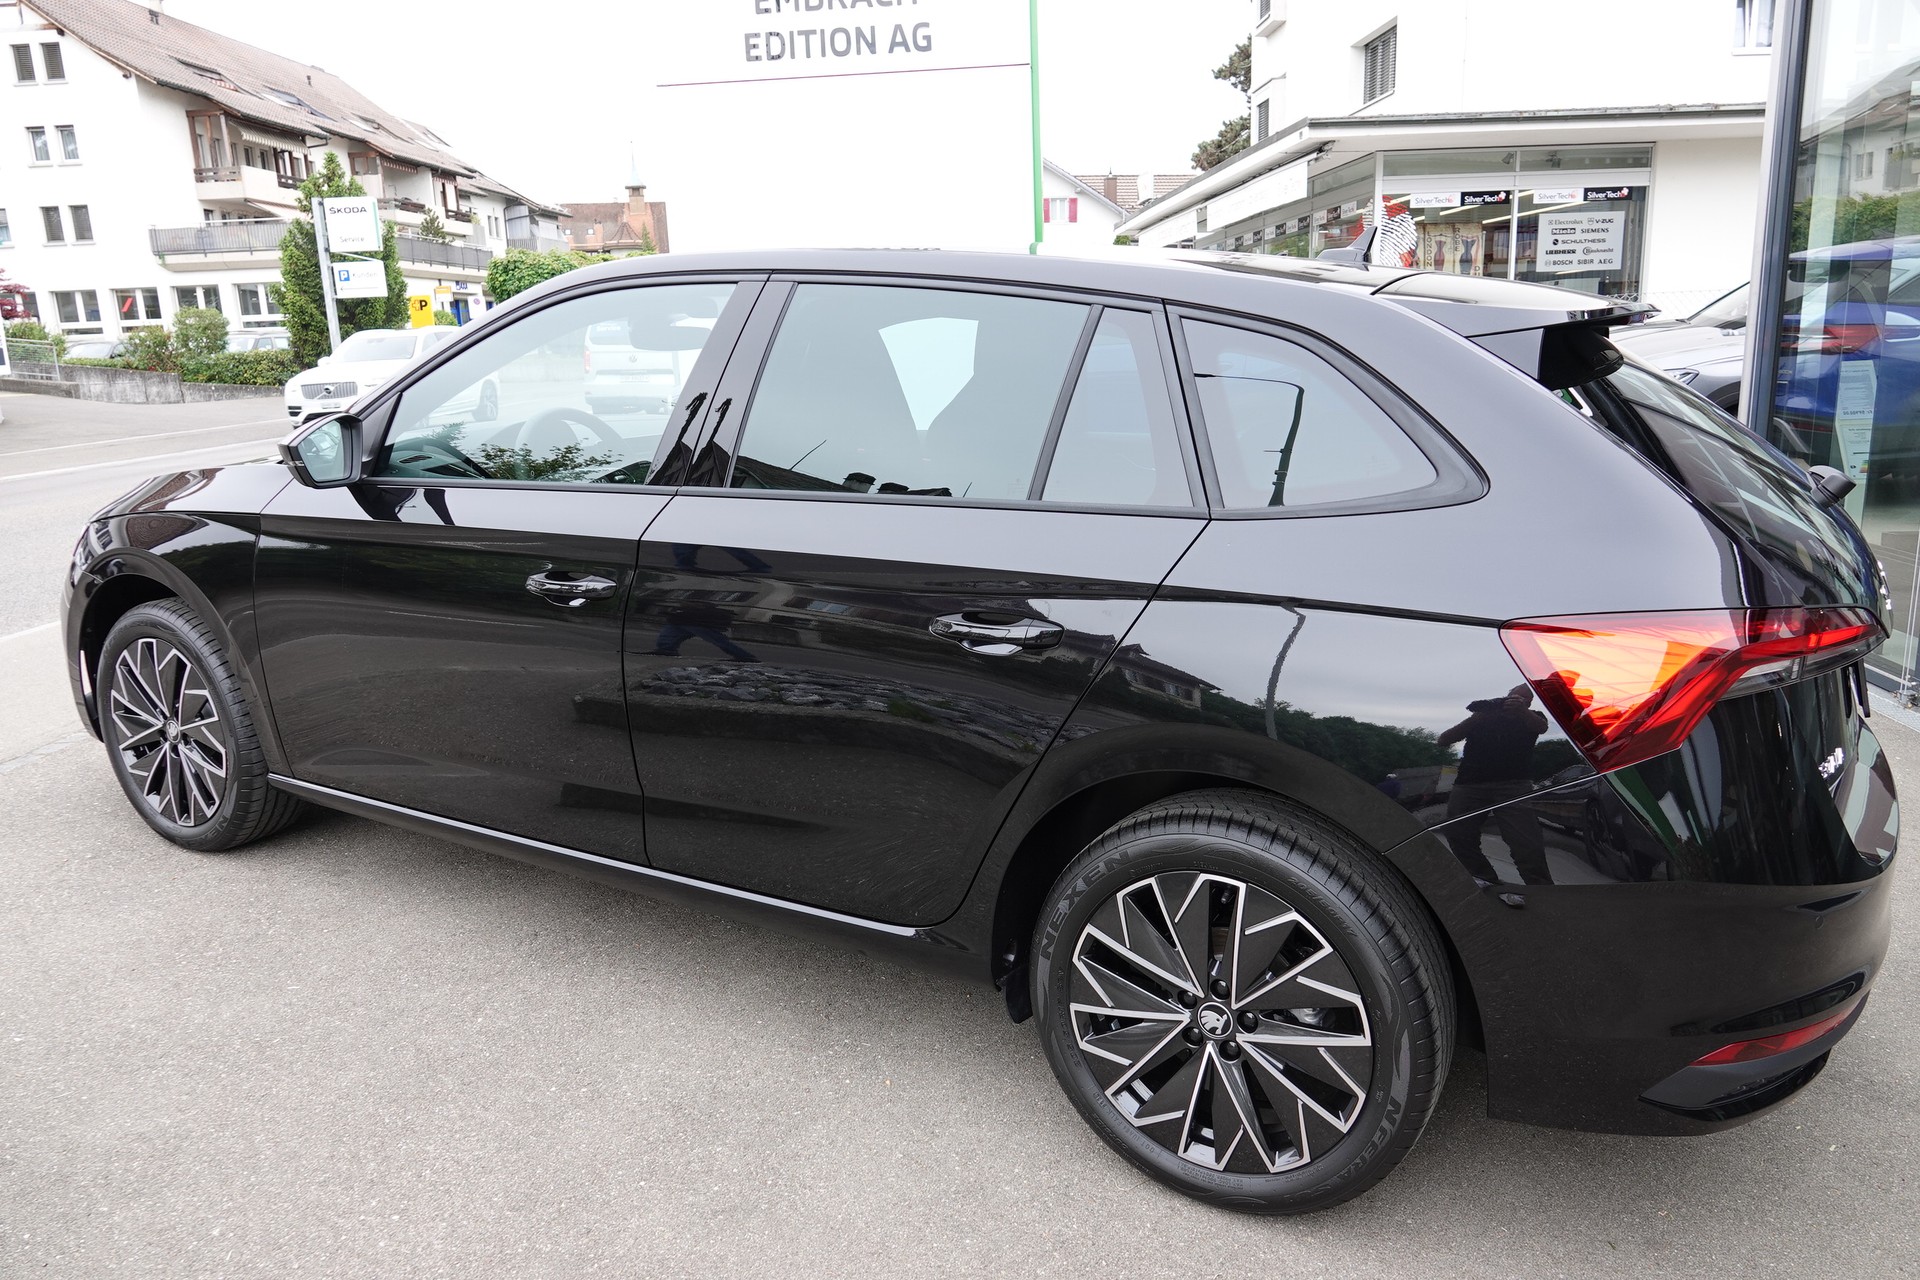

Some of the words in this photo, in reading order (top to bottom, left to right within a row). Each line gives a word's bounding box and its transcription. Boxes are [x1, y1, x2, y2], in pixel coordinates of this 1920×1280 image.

[744, 25, 877, 62] EDITION
[887, 21, 932, 54] AG
[1039, 849, 1133, 961] NEXEN
